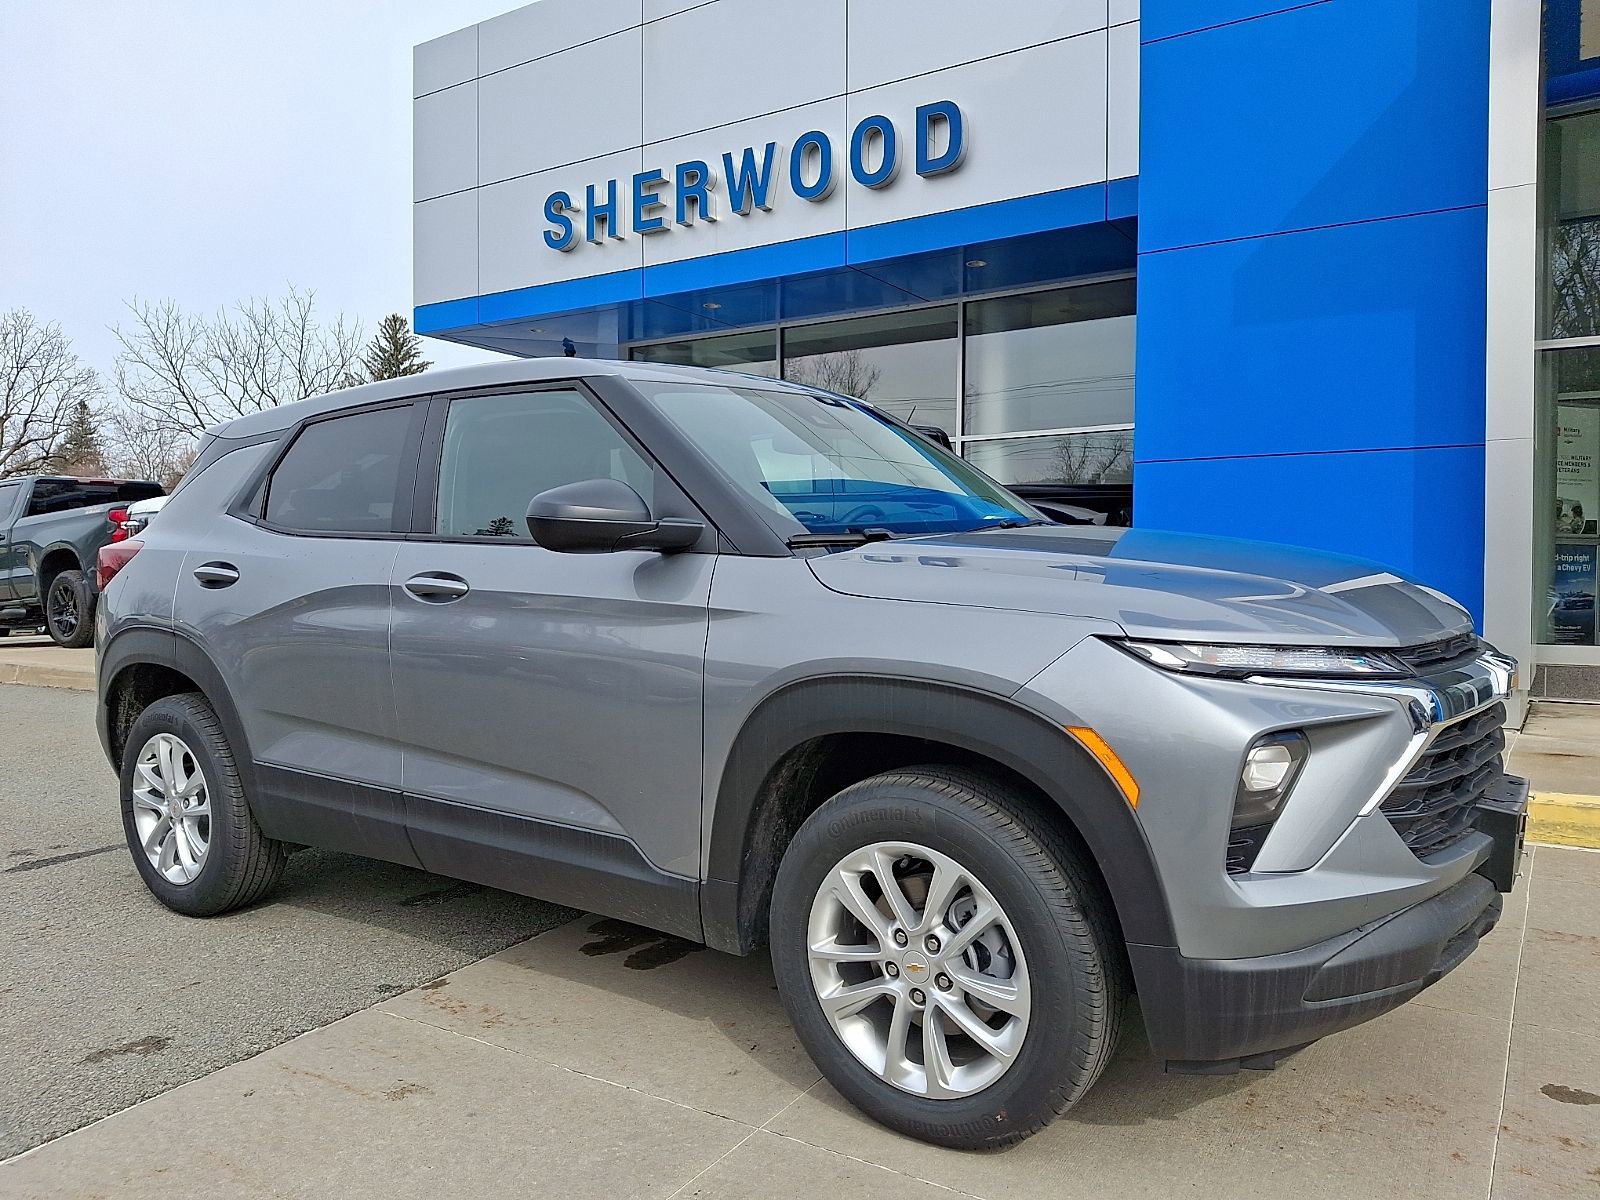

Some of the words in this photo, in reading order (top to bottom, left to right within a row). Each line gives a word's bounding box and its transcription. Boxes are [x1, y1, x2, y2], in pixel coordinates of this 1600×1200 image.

[543, 100, 966, 252] SHERWOOD
[1562, 564, 1582, 573] Chevy
[1583, 564, 1591, 572] EV
[1574, 553, 1590, 563] right
[827, 806, 909, 839] Continental
